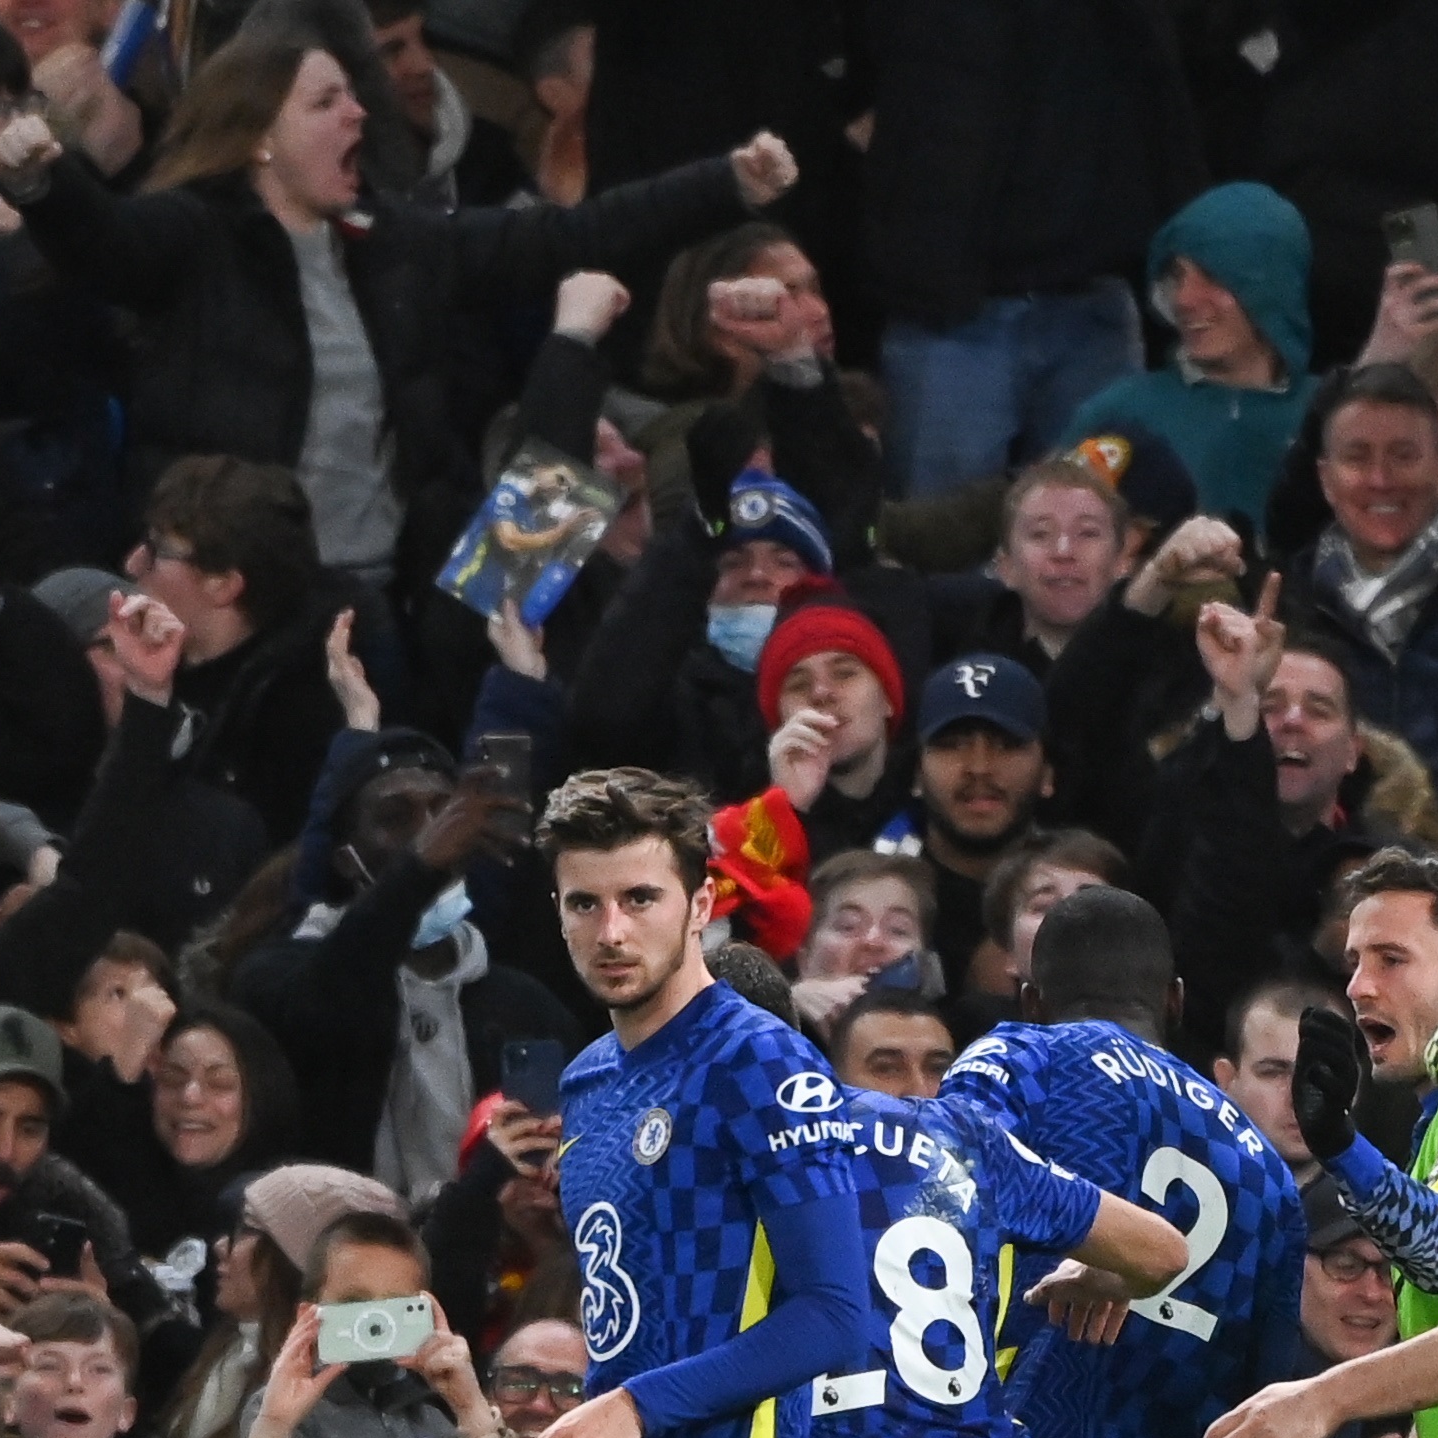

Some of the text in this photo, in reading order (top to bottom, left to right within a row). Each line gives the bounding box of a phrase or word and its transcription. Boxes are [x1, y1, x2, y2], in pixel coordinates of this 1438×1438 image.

[851, 1121, 977, 1214] UETA
[1091, 1038, 1264, 1157] RÜDIGER
[811, 1216, 989, 1416] 8
[1127, 1146, 1229, 1343] 2
